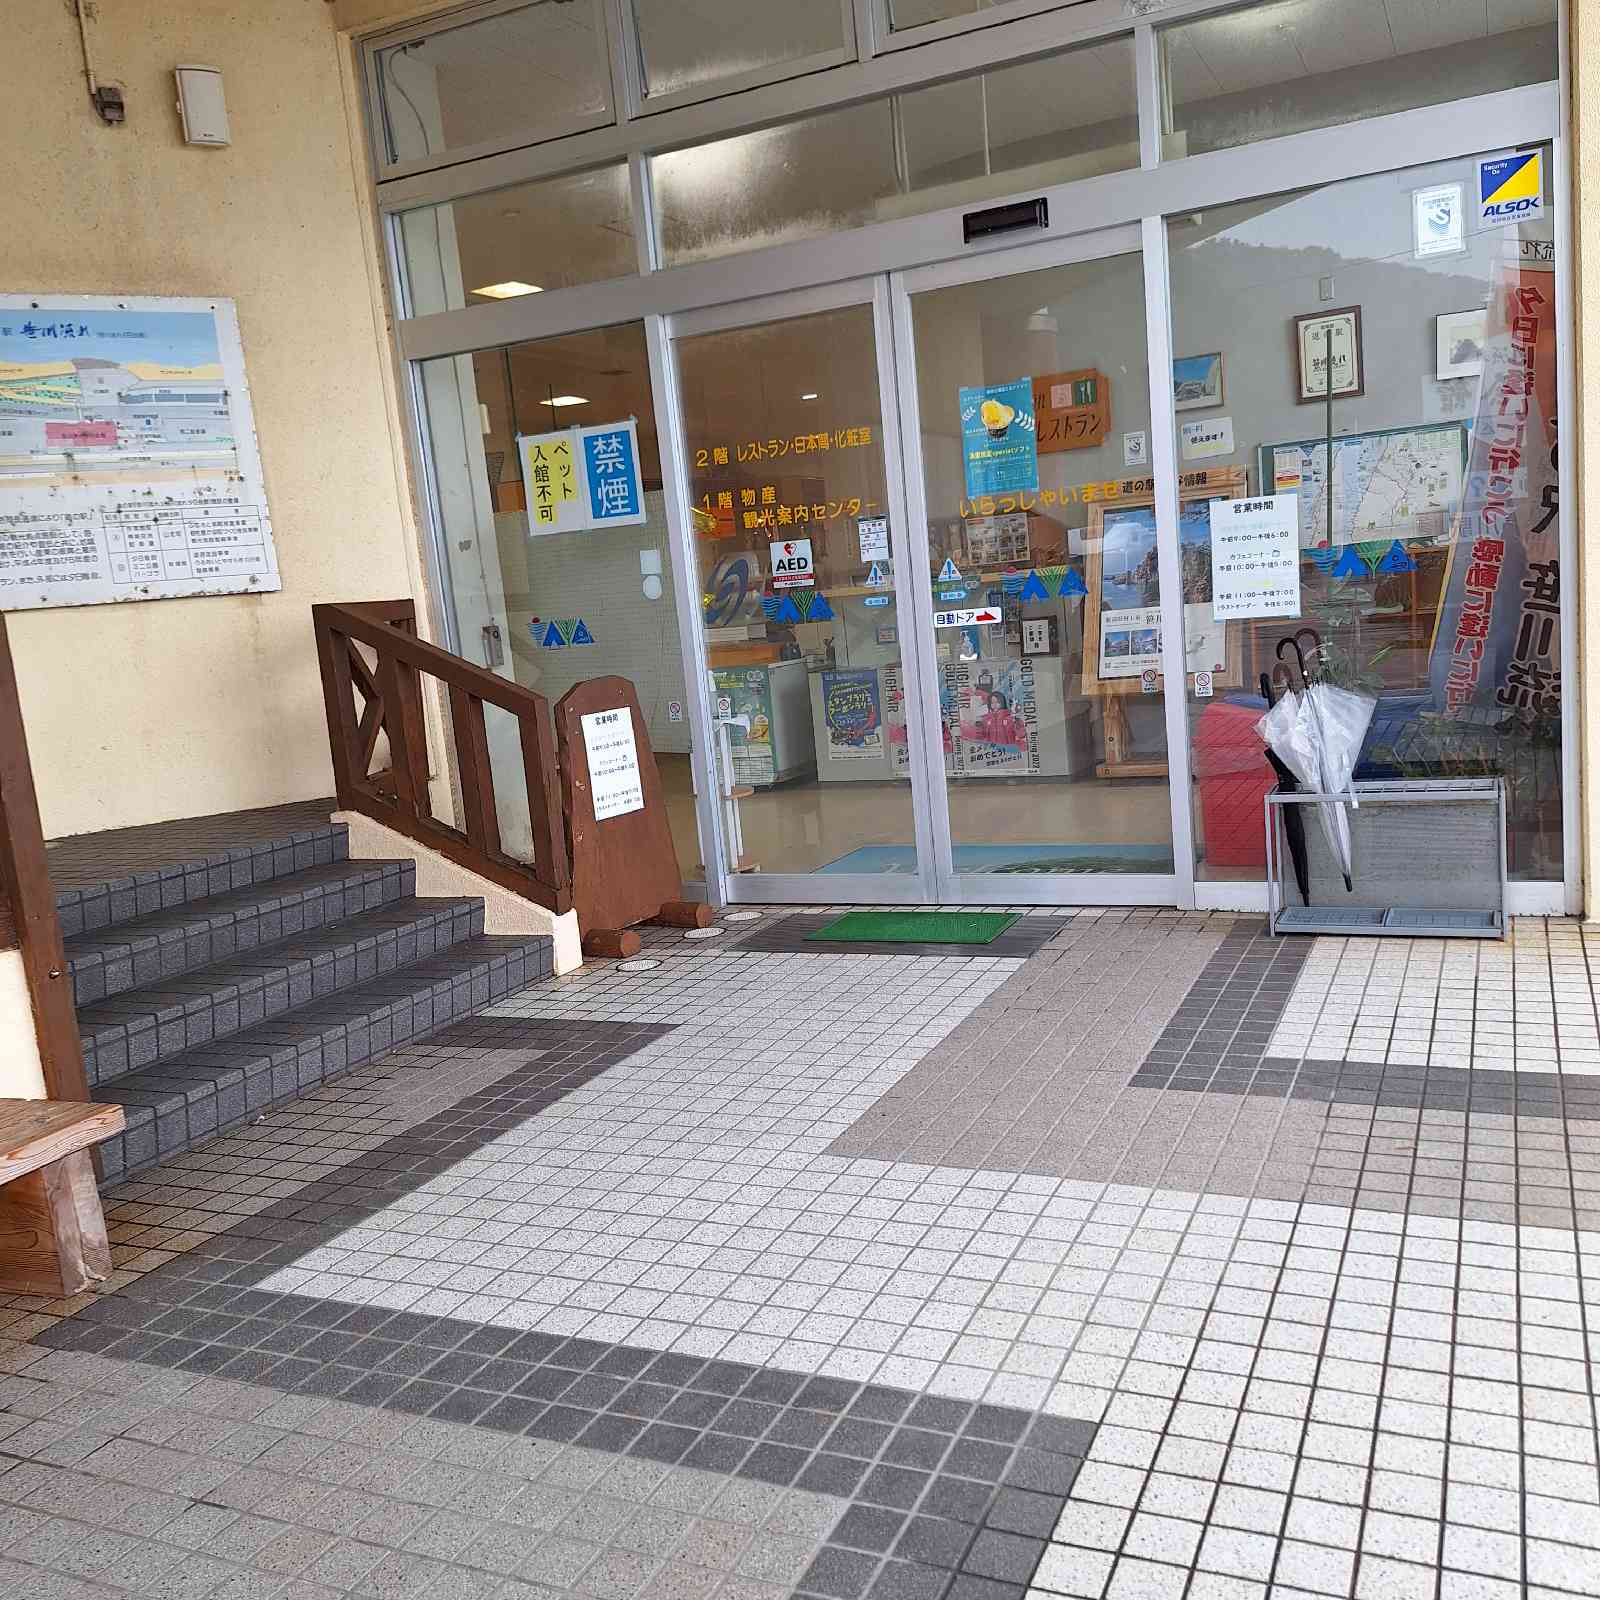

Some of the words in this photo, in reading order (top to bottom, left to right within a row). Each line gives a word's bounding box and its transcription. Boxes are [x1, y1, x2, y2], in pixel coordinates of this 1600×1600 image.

[1483, 197, 1540, 217] ALSOK
[1037, 413, 1101, 442] レストラン
[533, 445, 554, 522] 入館不可
[552, 440, 574, 500] ペット
[592, 434, 632, 516] 禁煙
[741, 485, 777, 506] 物産
[960, 481, 1121, 517] いらっしゃいませ
[1232, 500, 1274, 514] 営業時間
[743, 498, 877, 529] 観光案内センター
[776, 557, 808, 571] AED
[936, 611, 975, 625] 自動ドア
[1020, 657, 1034, 688] GOLD
[594, 713, 619, 726] 営業時間
[1023, 694, 1038, 727] MEDAL
